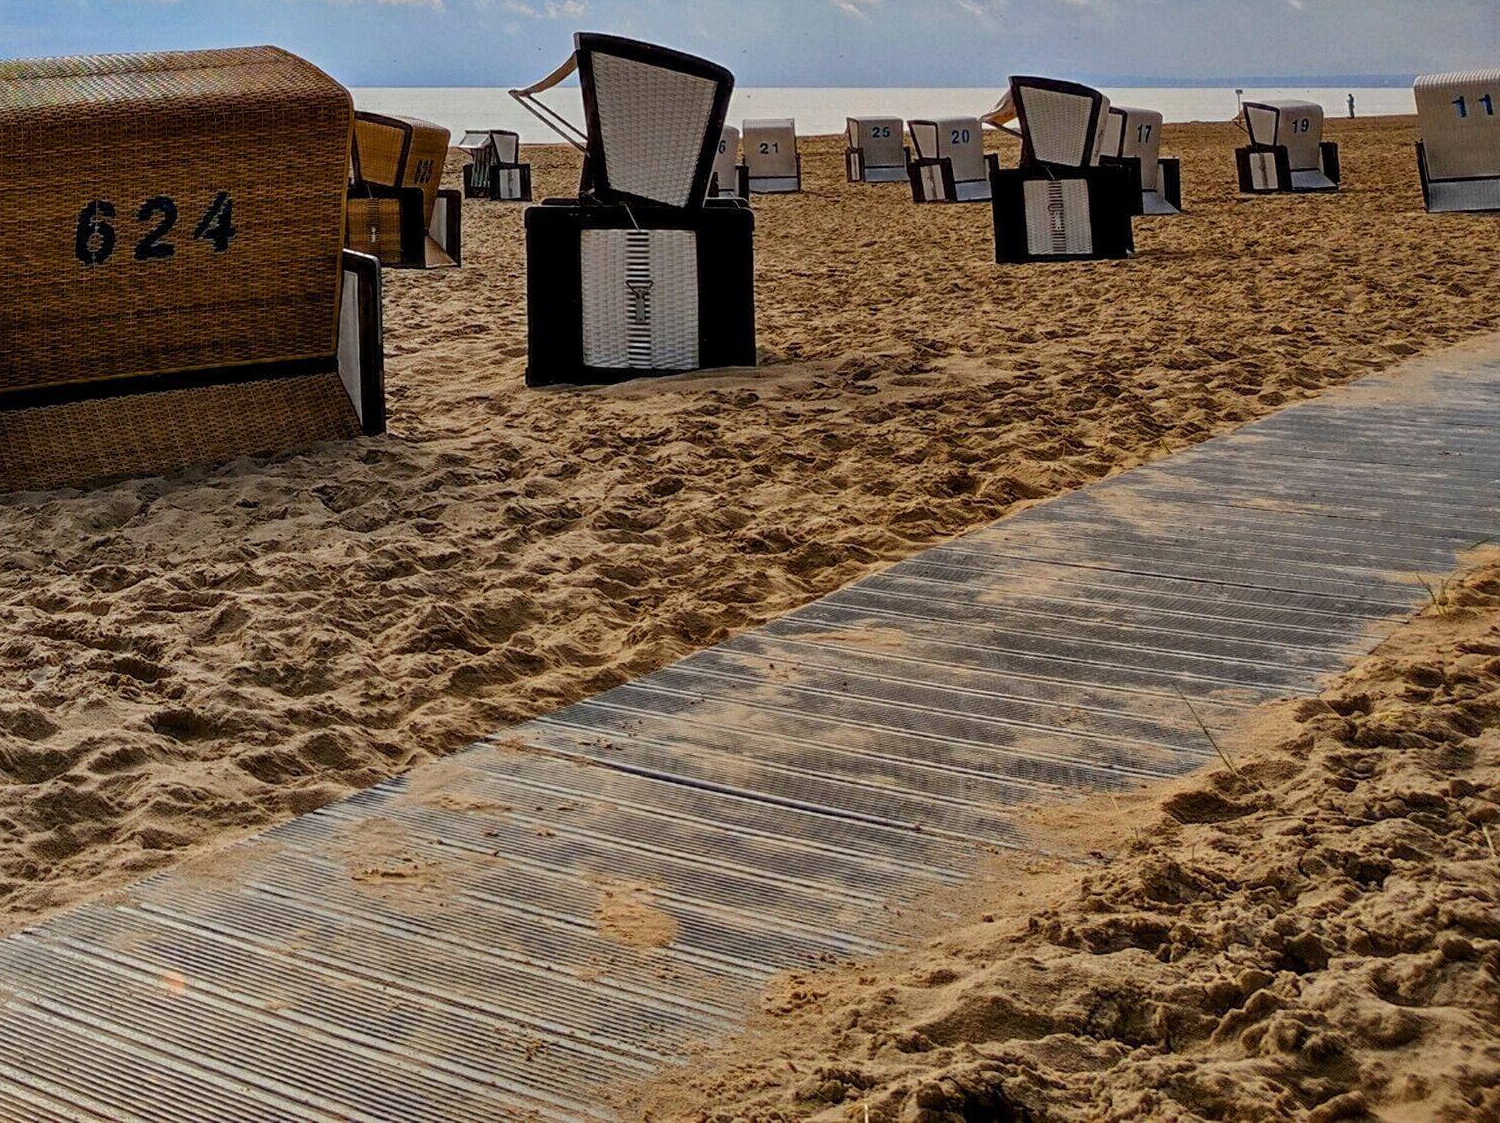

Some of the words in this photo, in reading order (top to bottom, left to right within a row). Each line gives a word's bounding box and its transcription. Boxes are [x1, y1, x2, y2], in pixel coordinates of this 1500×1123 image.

[1451, 94, 1493, 118] 11
[872, 126, 890, 138] 25
[1137, 124, 1152, 144] 17
[1292, 118, 1309, 134] 19
[951, 129, 970, 144] 20
[760, 142, 779, 154] 21
[75, 191, 236, 266] 624
